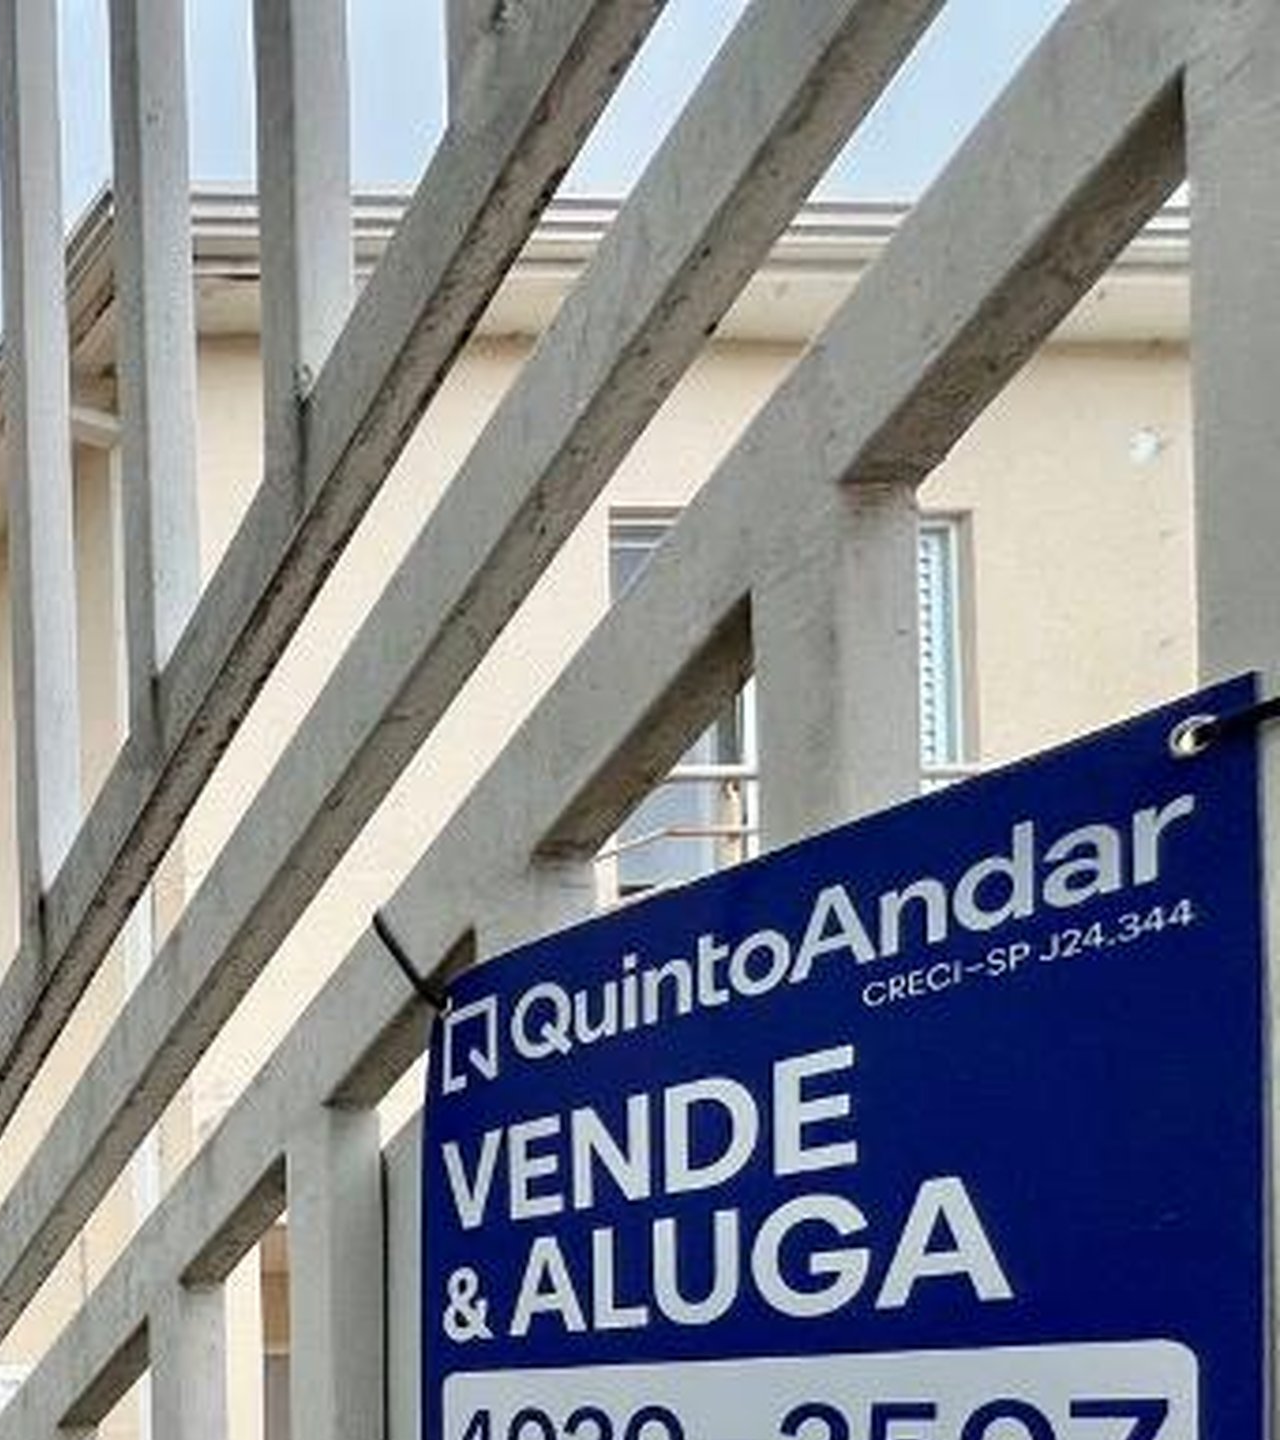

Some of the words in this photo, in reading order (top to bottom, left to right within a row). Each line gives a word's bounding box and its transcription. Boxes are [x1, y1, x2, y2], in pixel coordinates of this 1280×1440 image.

[509, 795, 1196, 1060] QuintoAndar
[862, 943, 1032, 1008] CRECI-SP
[1038, 898, 1196, 962] J24.344
[442, 1044, 860, 1230] VENDE
[442, 1266, 494, 1343] &
[510, 1176, 1014, 1336] ALUGA
